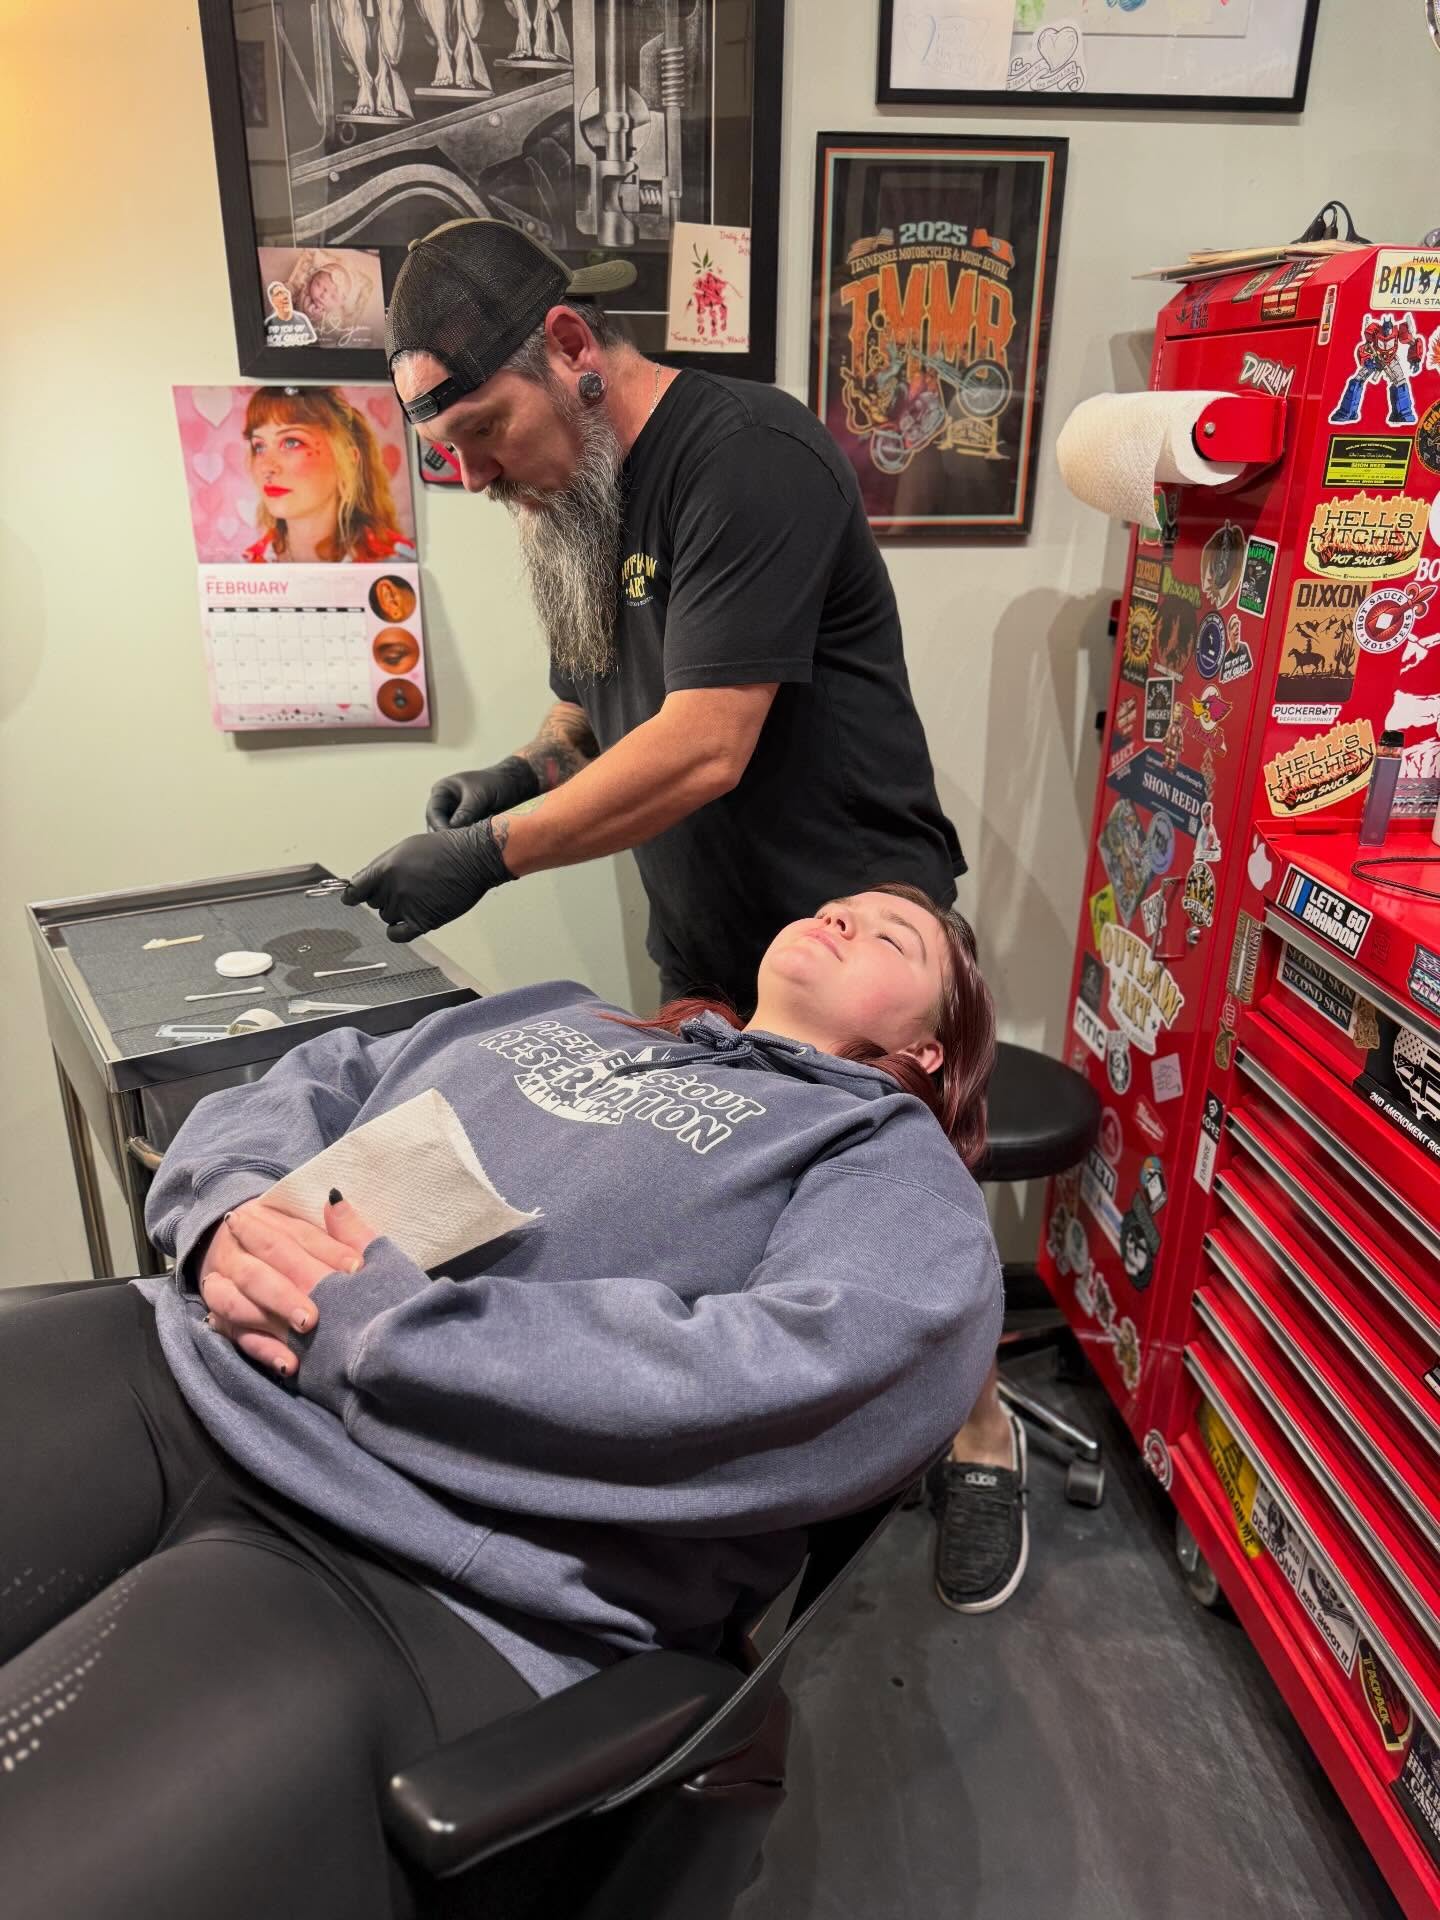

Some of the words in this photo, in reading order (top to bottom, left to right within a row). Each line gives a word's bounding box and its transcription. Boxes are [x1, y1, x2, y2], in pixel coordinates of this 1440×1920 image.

[900, 221, 968, 245] 2025
[850, 249, 897, 274] TENNESSEE
[899, 246, 952, 259] MOTORCYCLES
[953, 251, 960, 260] &
[960, 250, 982, 267] MUSIC
[982, 256, 1009, 280] REVIVAL
[1379, 266, 1415, 294] BAD
[841, 260, 1016, 386] TMMR
[1240, 354, 1295, 399] DURHAM
[1310, 528, 1422, 546] KITCHEN
[1325, 510, 1413, 528] HELL'S
[621, 552, 658, 585] UTLAW
[1330, 553, 1351, 564] HOT
[1352, 555, 1386, 565] SAUCE
[206, 581, 288, 595] FEBRUARY
[629, 576, 645, 599] ART
[1296, 584, 1368, 608] DIXXON
[1357, 607, 1369, 631] HOT
[1369, 592, 1404, 606] SAUCE
[1362, 614, 1412, 650] HOLSTERS
[1147, 708, 1171, 720] WHISKEY
[1268, 743, 1374, 796] KITCHEN
[1276, 734, 1361, 778] HELL'S
[1143, 771, 1171, 800] SHON
[1171, 785, 1200, 816] REED
[1296, 791, 1316, 803] HOT
[1317, 777, 1349, 797] SAUCE
[1302, 905, 1361, 954] BRANDON
[1309, 885, 1346, 922] LET'S
[1346, 909, 1367, 934] GO
[1101, 925, 1182, 1028] OUTLAW
[1286, 943, 1328, 983] SECOND
[1328, 971, 1355, 1000] SKIN
[1118, 977, 1153, 1033] ART
[1283, 964, 1323, 1003] SECOND
[1324, 994, 1350, 1025] SKIN
[478, 1029, 732, 1155] RESERVATION
[1369, 1091, 1384, 1108] 2ND
[1383, 1103, 1428, 1145] AMENDMENT
[1233, 1502, 1245, 1527] ON
[1241, 1523, 1257, 1548] ME
[1252, 1511, 1298, 1587] DECISIONS
[1300, 1588, 1318, 1613] JUST
[1317, 1612, 1342, 1650] SHOOT
[1341, 1648, 1350, 1664] IT
[1363, 1651, 1392, 1728] TACPACK
